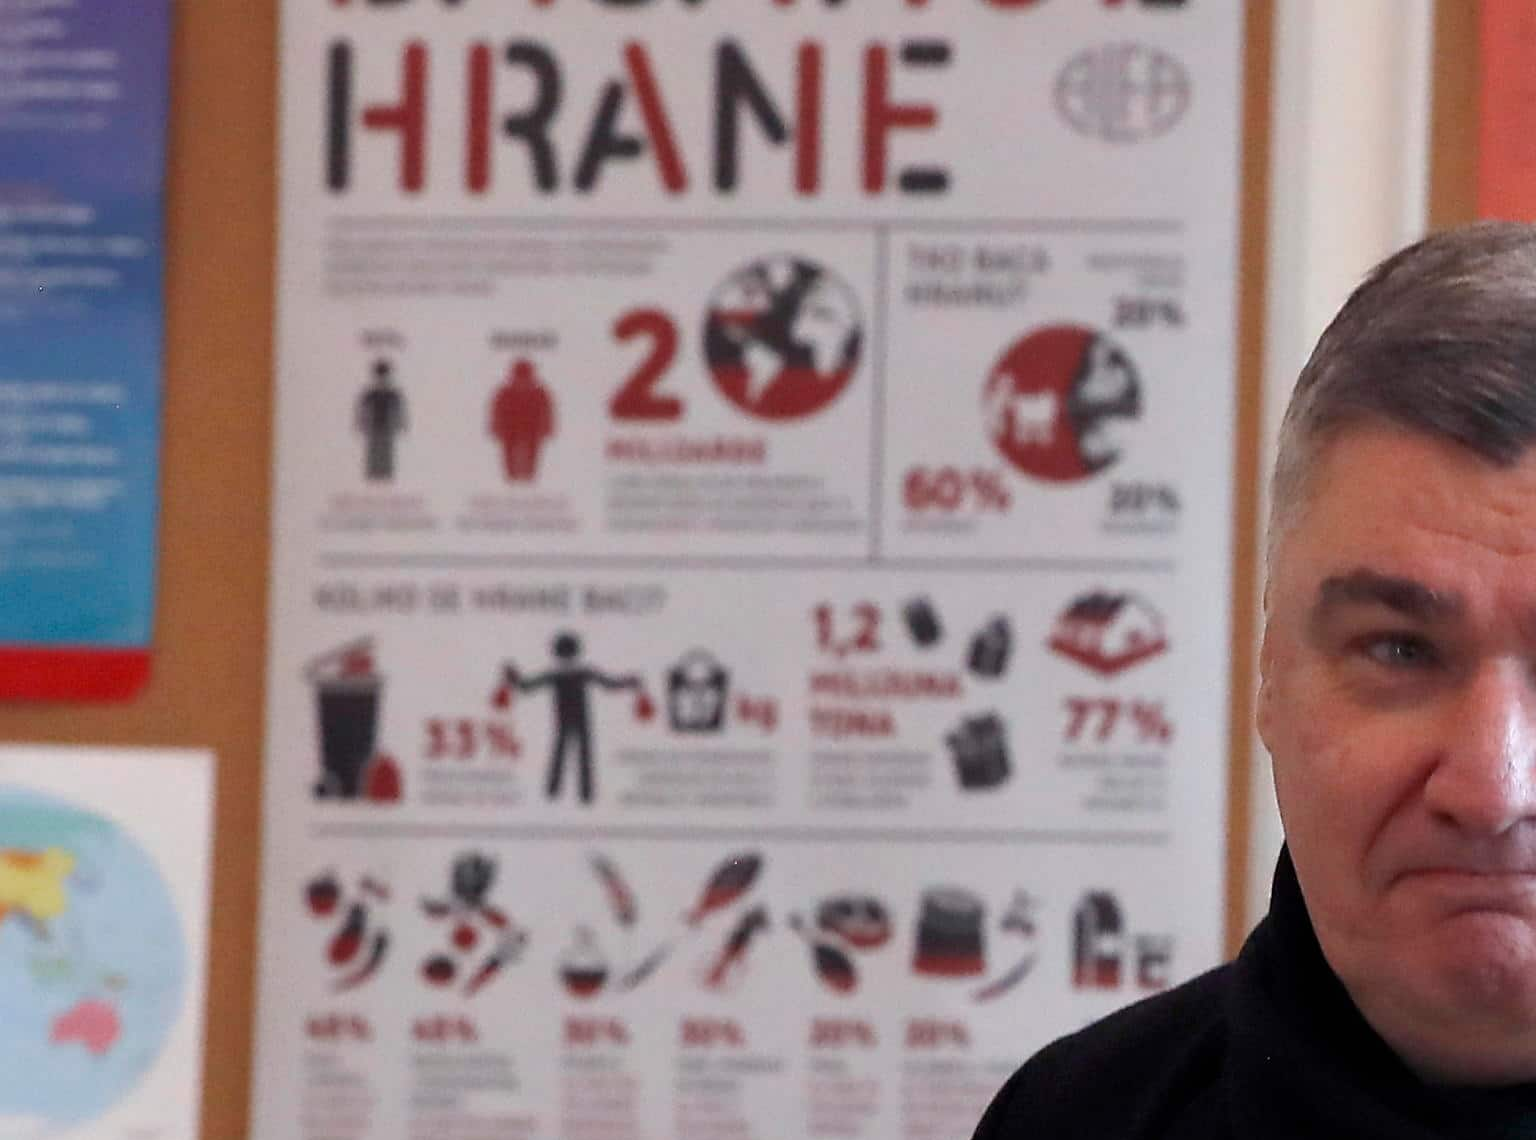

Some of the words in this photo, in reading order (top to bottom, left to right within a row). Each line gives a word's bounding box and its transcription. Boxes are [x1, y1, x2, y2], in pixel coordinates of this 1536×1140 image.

[327, 37, 952, 195] HRANE
[608, 308, 685, 422] 2
[904, 466, 1013, 511] 60%
[813, 601, 882, 657] 1,2
[736, 695, 779, 733] kg
